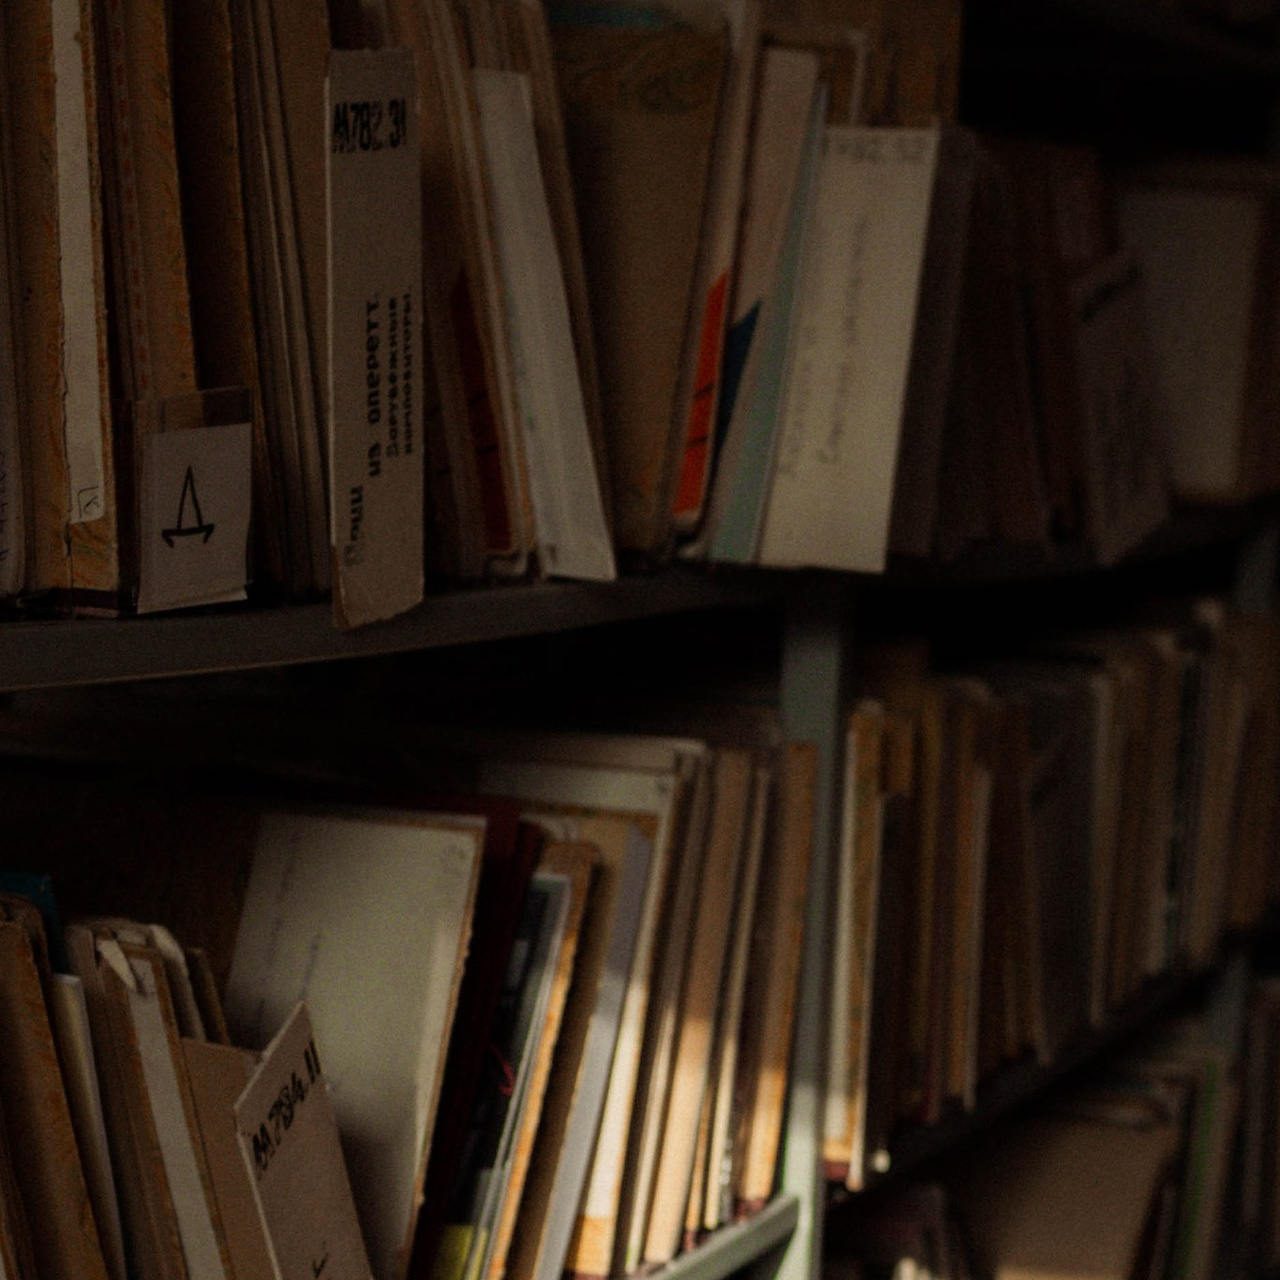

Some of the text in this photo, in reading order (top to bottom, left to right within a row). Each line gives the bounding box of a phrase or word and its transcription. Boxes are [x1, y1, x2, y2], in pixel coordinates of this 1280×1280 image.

[385, 296, 399, 457] Зарубежные
[367, 442, 381, 477] из
[162, 465, 215, 548] Д
